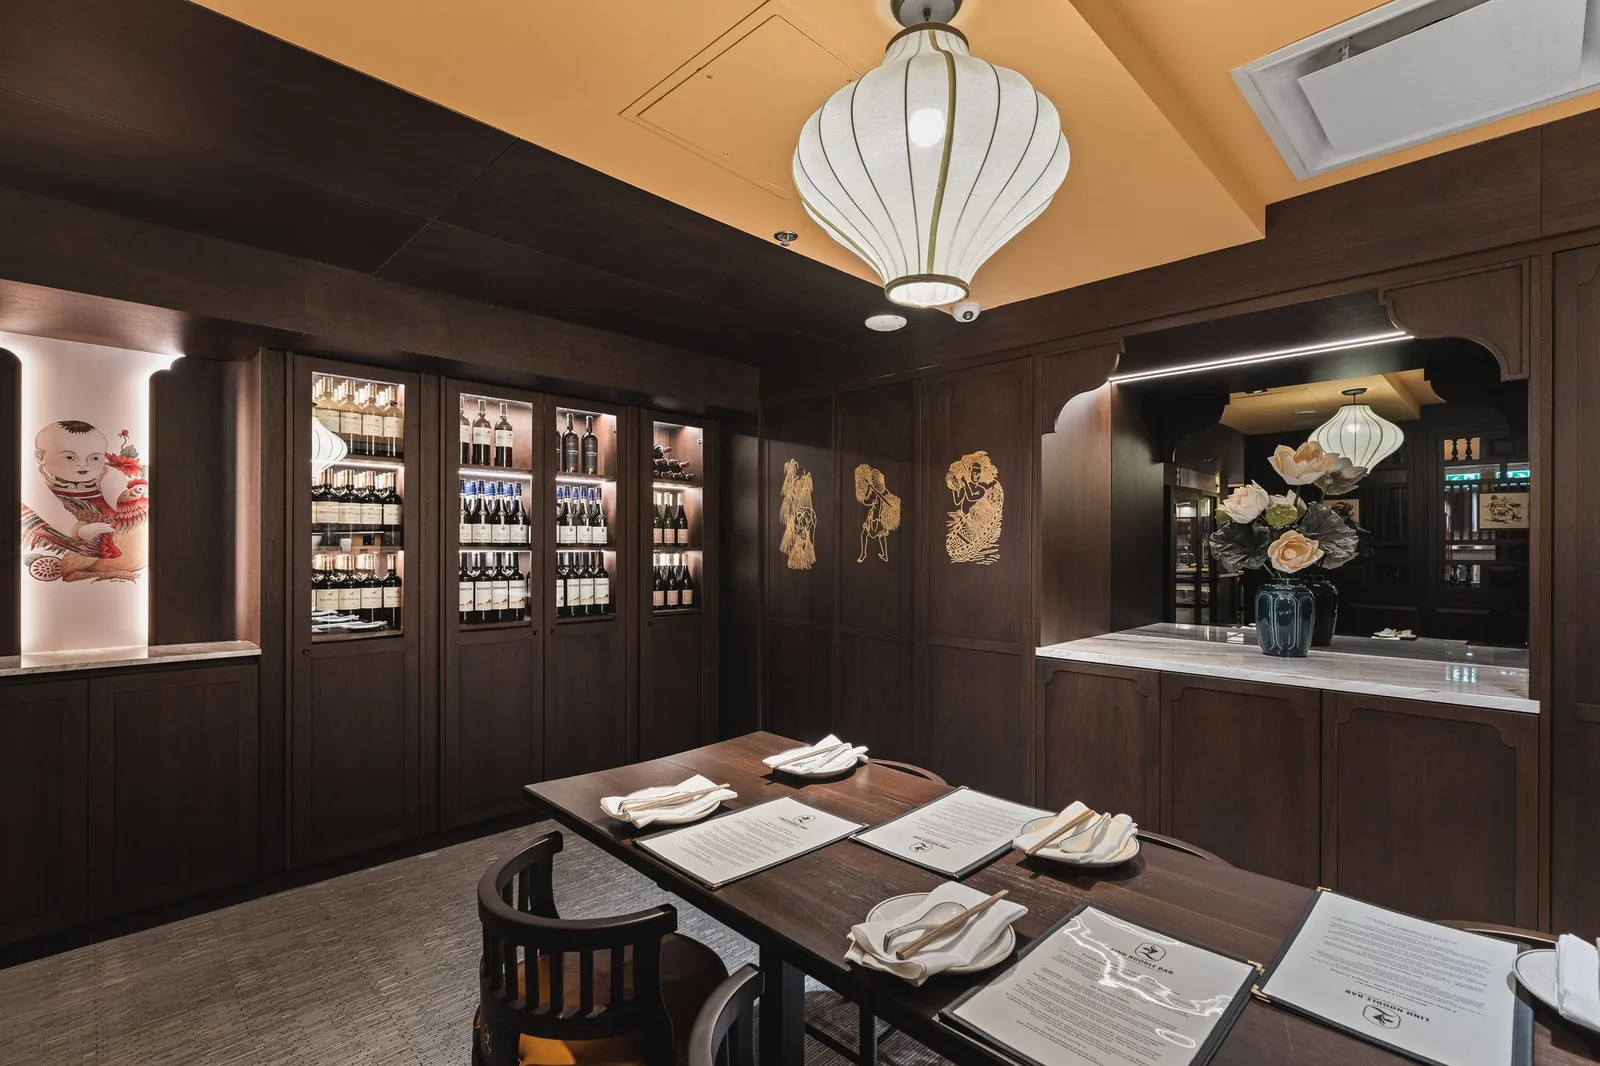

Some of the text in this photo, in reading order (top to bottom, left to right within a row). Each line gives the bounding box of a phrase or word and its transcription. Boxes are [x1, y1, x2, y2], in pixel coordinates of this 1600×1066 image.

[1128, 955, 1157, 968] NOODLE
[1158, 966, 1174, 975] BAR
[1344, 988, 1430, 1022] LINH NOODLE BAR
